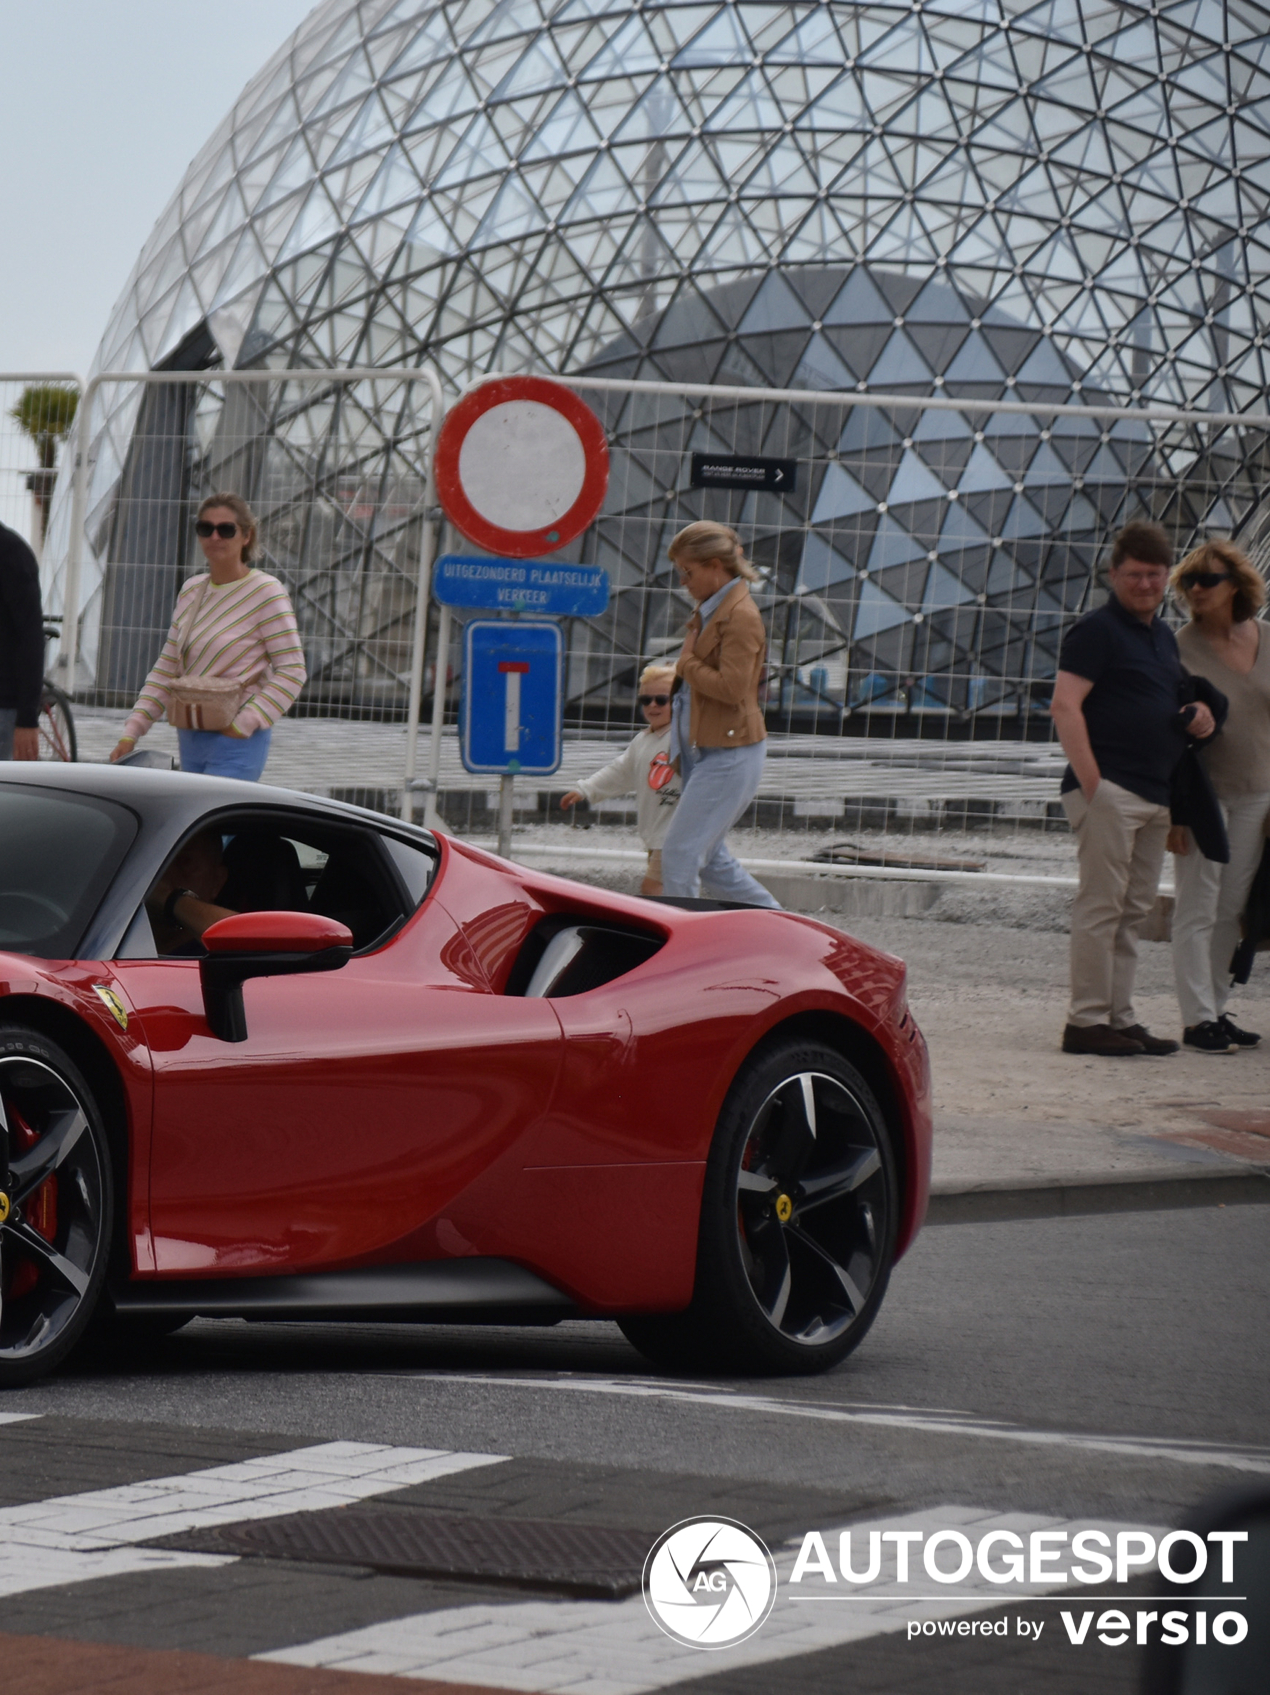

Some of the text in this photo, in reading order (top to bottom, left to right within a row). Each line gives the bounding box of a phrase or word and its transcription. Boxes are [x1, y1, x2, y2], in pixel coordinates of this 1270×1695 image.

[444, 563, 602, 587] UITGEZONDERD PLAATSELIJK
[497, 588, 547, 604] VERKEER
